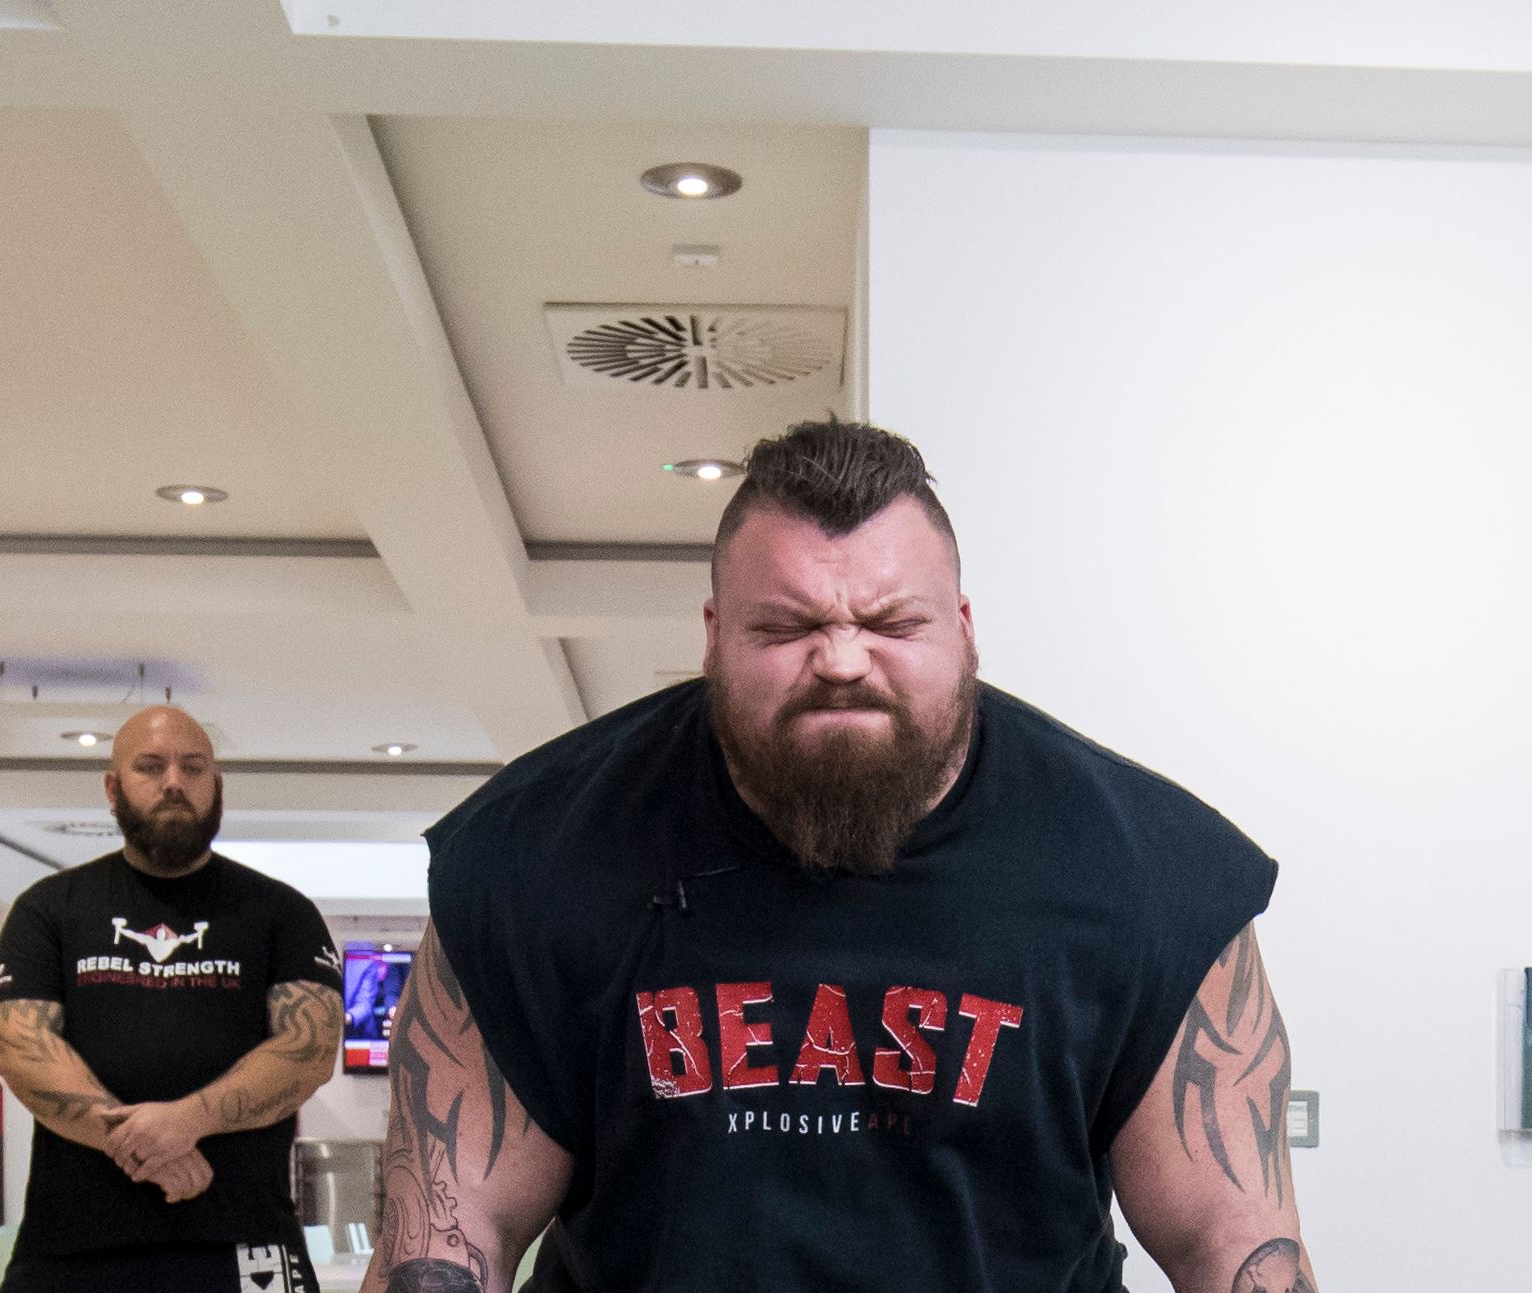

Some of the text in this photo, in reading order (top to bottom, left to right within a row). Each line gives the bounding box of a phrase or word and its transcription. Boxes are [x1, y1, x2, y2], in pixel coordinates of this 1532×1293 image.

[77, 956, 240, 978] REBEL STRENGTH
[636, 981, 1024, 1107] BEAST
